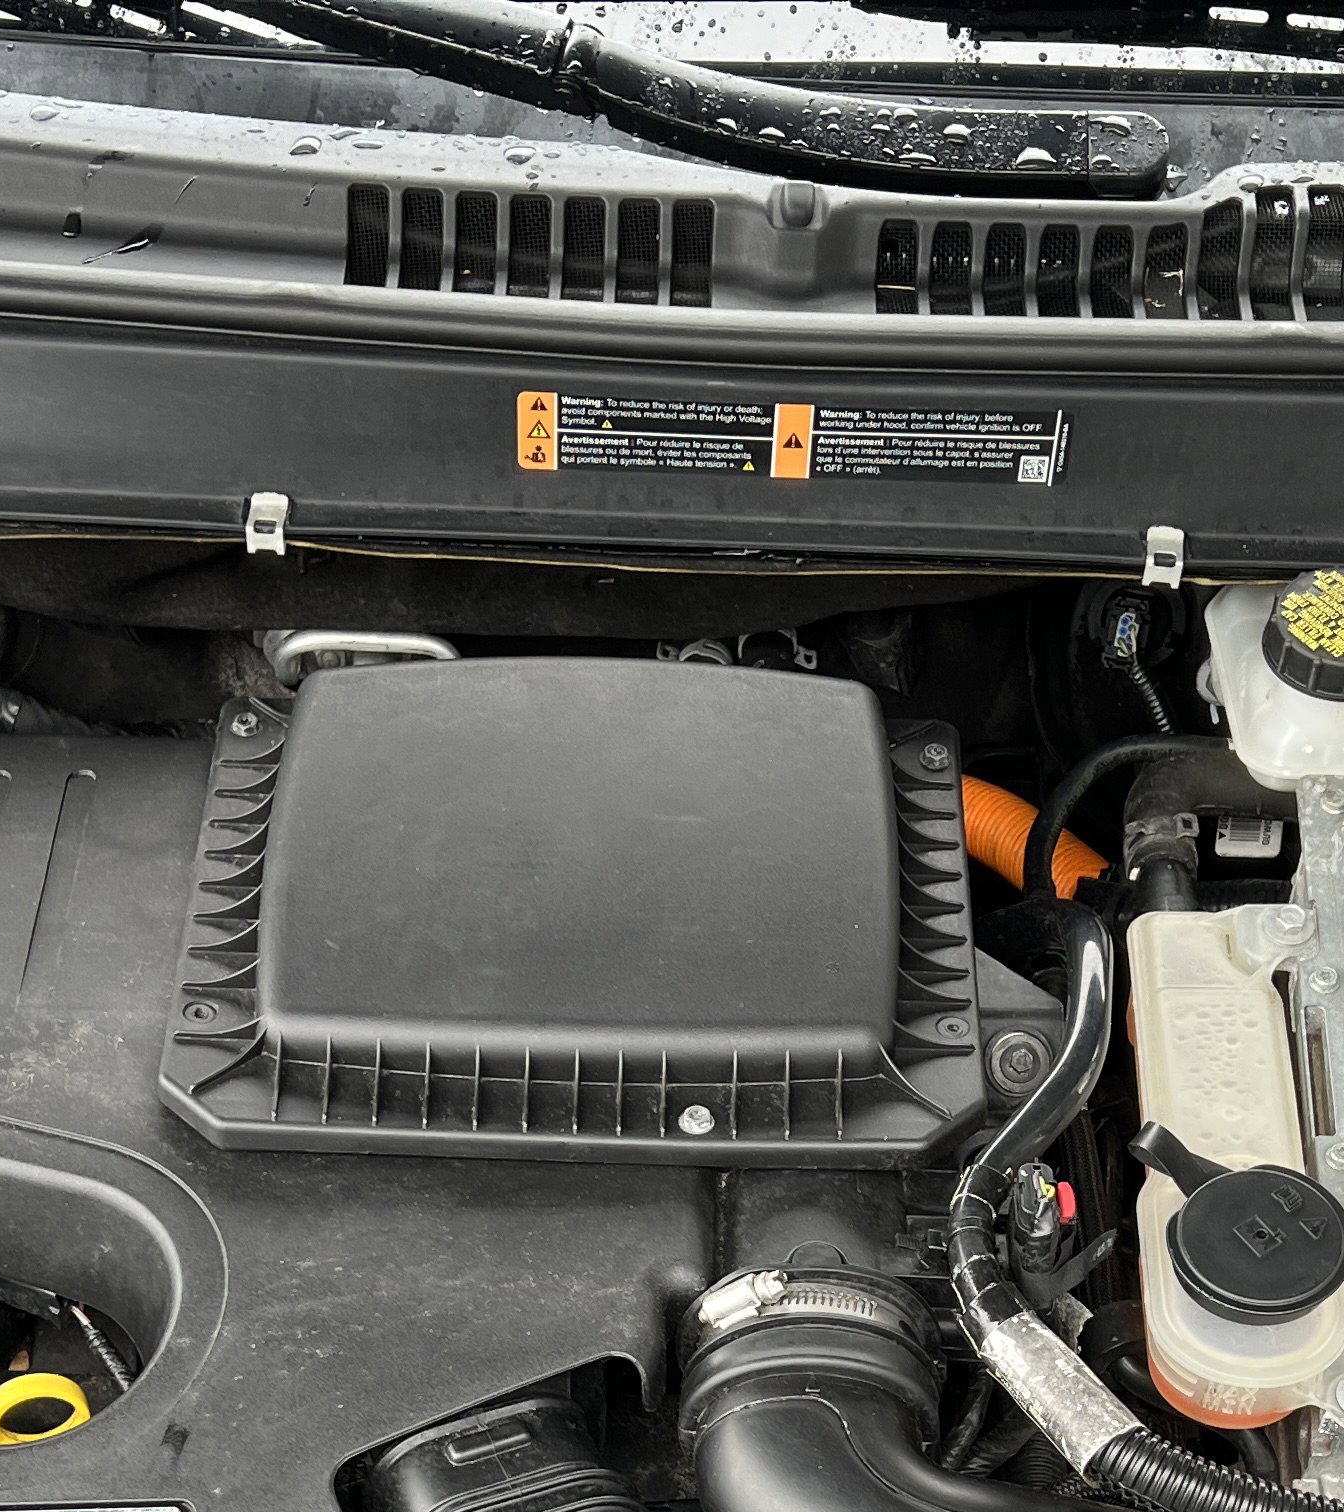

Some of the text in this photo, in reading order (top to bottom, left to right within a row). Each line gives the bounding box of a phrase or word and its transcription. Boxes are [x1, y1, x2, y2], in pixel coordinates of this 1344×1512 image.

[560, 395, 603, 408] Warning:
[606, 398, 617, 407] To
[619, 399, 650, 408] reduce
[651, 401, 666, 409] the
[668, 401, 684, 410] risk
[686, 402, 695, 411] of
[696, 402, 721, 413] injury
[561, 405, 772, 425] avoid components marked with the High Voltage
[561, 415, 597, 426] Symbol.
[819, 408, 862, 420] Warning:
[865, 410, 876, 418] To
[877, 410, 908, 419] reduce
[910, 411, 925, 420] the
[926, 411, 942, 420] risk
[944, 412, 954, 420] of
[984, 413, 1013, 422] before
[818, 418, 853, 429] working
[855, 419, 881, 428] under
[910, 420, 943, 430] confirm
[945, 421, 976, 431] vehicle
[978, 422, 1010, 433] ignition
[1012, 424, 1020, 432] is
[561, 434, 744, 451] Avertissement Pour réduire le risque de
[817, 435, 1040, 450] Avertissement Pour réduire le risque de blessures
[561, 443, 603, 454] blessures
[618, 446, 630, 455] de
[656, 447, 682, 457] éviter
[683, 449, 696, 458] les
[698, 450, 752, 461] composants
[816, 445, 833, 454] lors
[834, 445, 859, 454] d'une
[860, 446, 911, 456] intervention
[560, 453, 575, 464] qui
[576, 454, 607, 466] portent
[608, 456, 618, 464] le
[619, 456, 656, 468] symbole
[666, 458, 692, 467] Haute
[694, 459, 727, 468] tension
[815, 455, 833, 464] que
[834, 455, 843, 463] le
[844, 455, 901, 465] commutateur
[951, 459, 964, 467] est
[979, 459, 1013, 470] position
[823, 463, 843, 472] OFF
[1202, 1396, 1256, 1416] MIN
